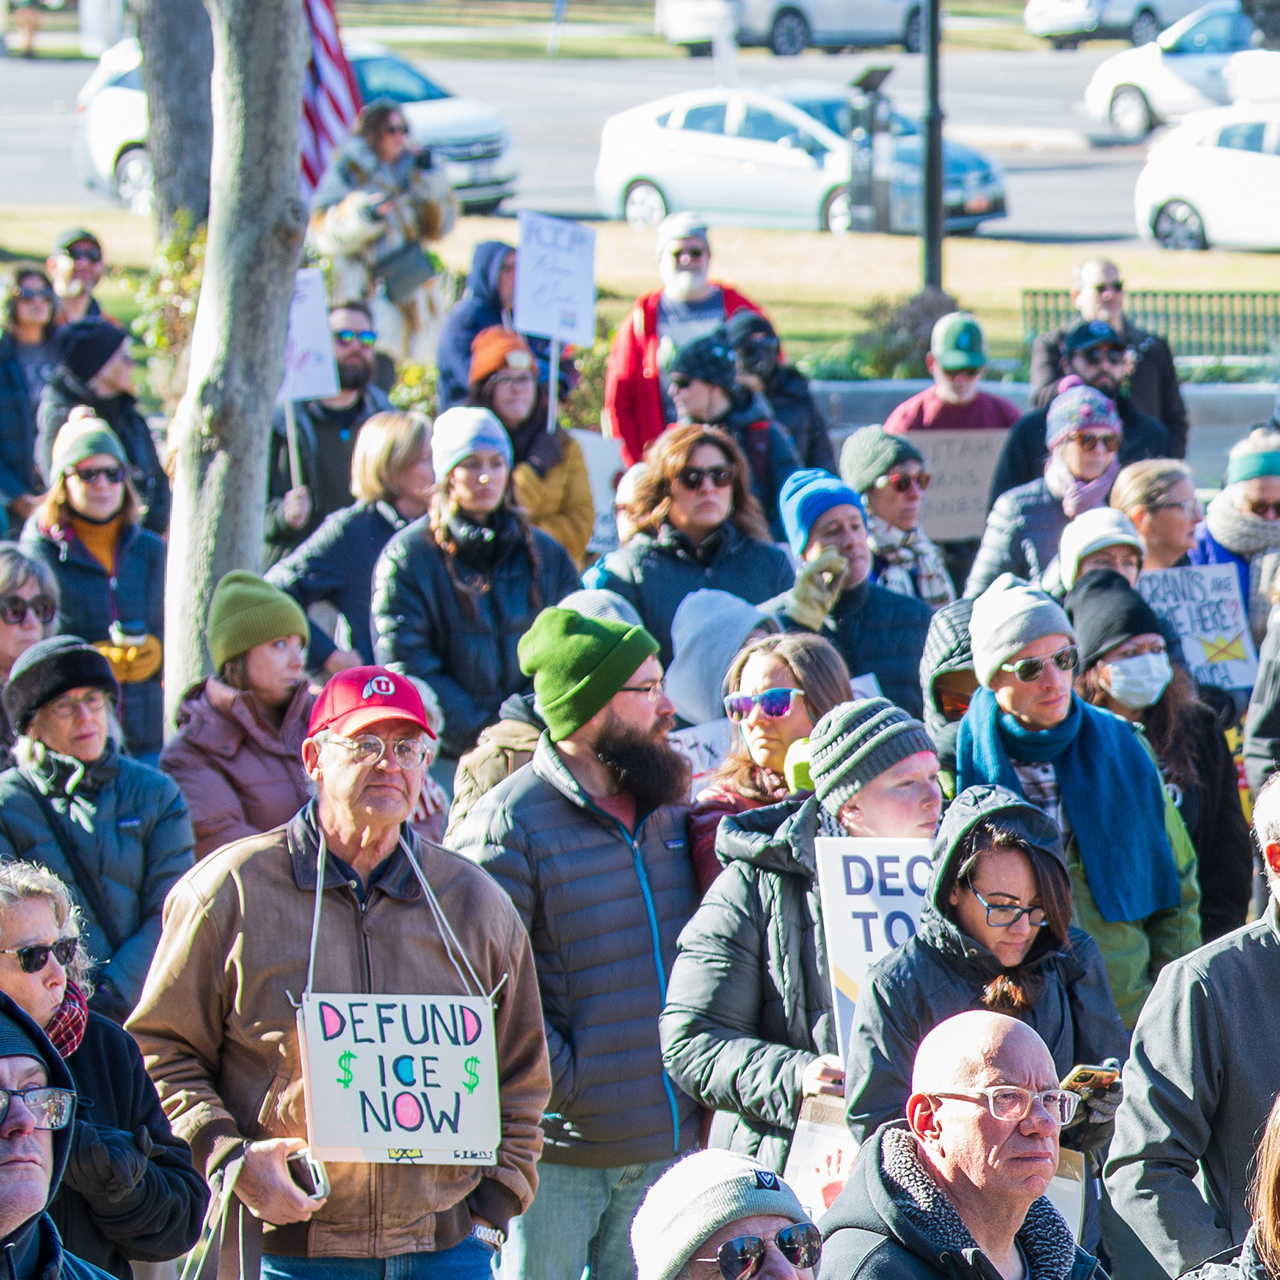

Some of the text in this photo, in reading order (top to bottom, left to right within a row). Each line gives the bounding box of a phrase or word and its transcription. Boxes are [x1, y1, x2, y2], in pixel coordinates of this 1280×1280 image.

[851, 909, 917, 953] TO
[318, 1001, 482, 1046] DEFUND
[377, 1054, 441, 1088] ICE
[359, 1090, 461, 1134] NOW
